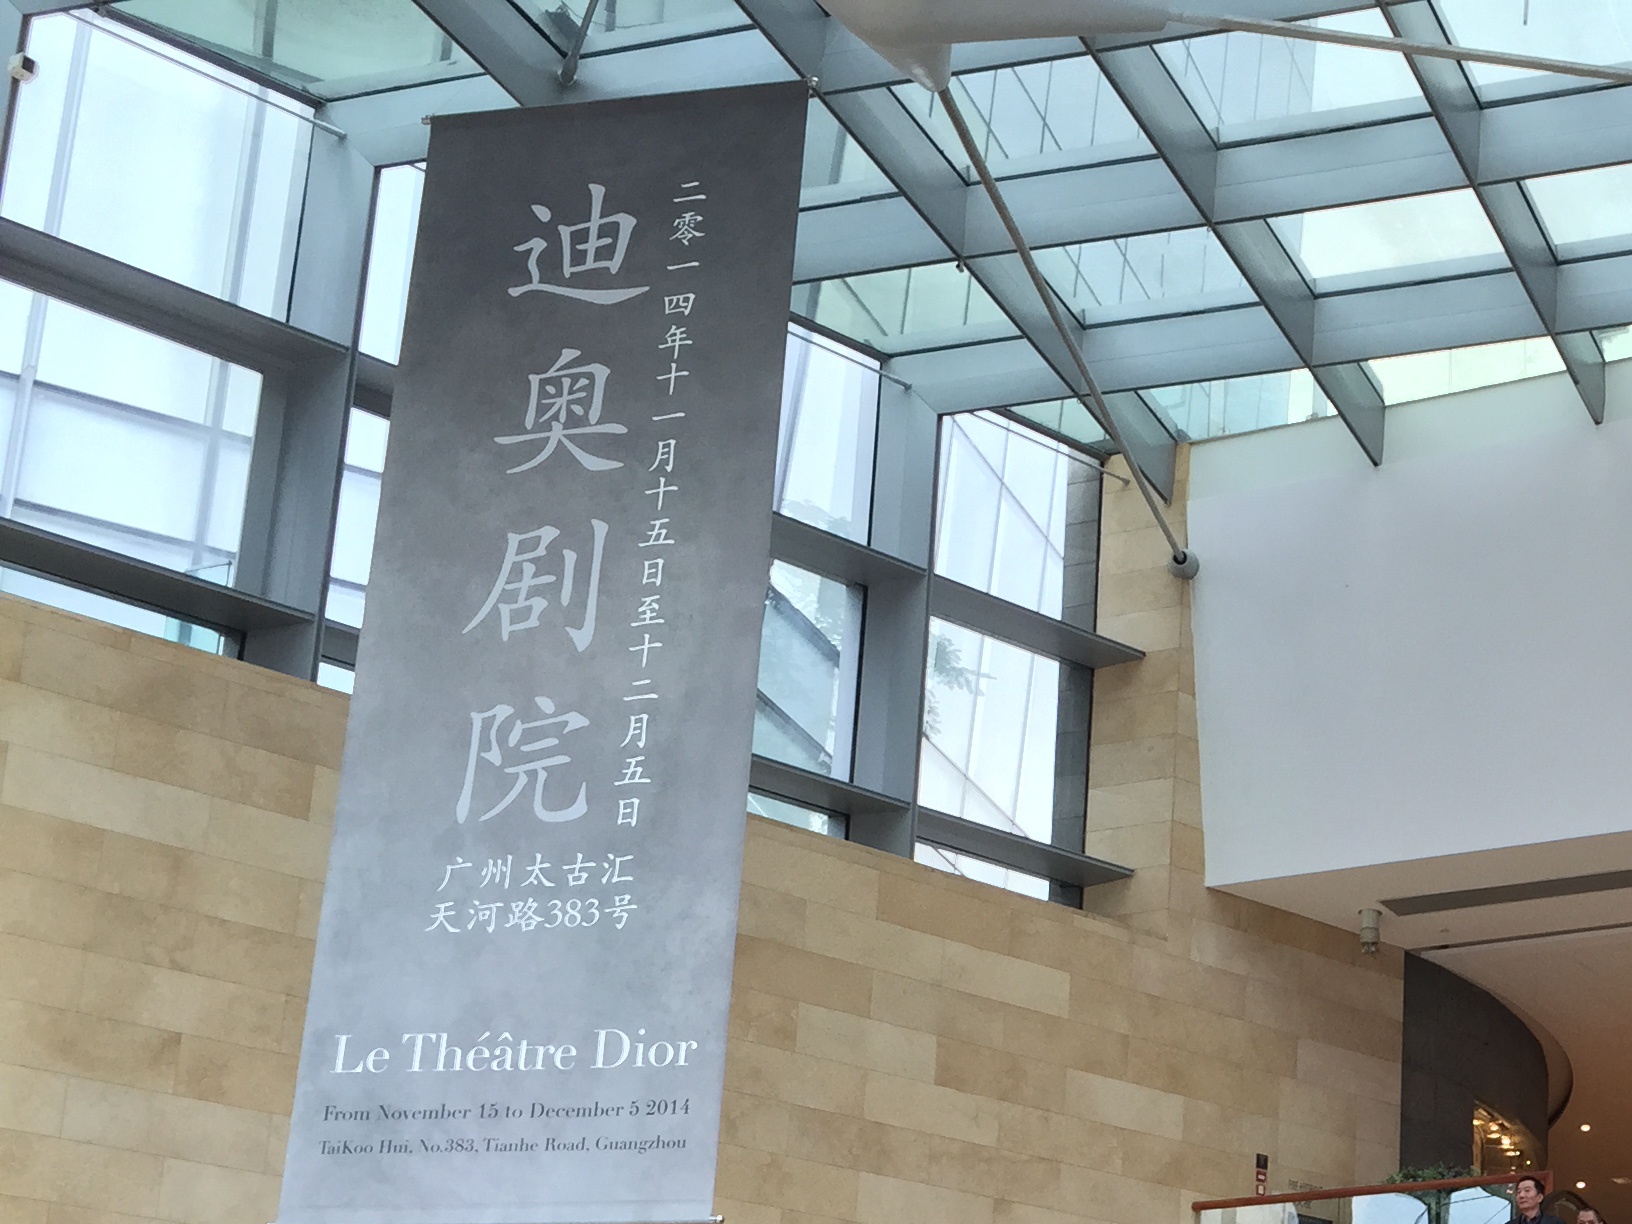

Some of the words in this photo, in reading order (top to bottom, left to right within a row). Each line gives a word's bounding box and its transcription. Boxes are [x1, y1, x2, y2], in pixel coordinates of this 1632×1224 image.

[456, 183, 650, 825] 迪奥剧院
[614, 182, 706, 828] 二零一四年十一月十五日至十二月五日
[437, 852, 635, 892] 广州太古汇
[424, 893, 639, 933] 天河路383号
[330, 1034, 390, 1074] Le
[402, 1031, 577, 1073] Théâtre
[590, 1028, 699, 1069] Dior
[323, 1105, 370, 1122] From
[377, 1104, 472, 1121] November
[478, 1102, 499, 1119] 15
[504, 1102, 523, 1119] to
[529, 1100, 625, 1120] December
[628, 1100, 640, 1117] 5
[645, 1098, 691, 1117] 2014
[482, 1137, 539, 1153] Tianhe
[595, 1134, 688, 1155] Guangzhou
